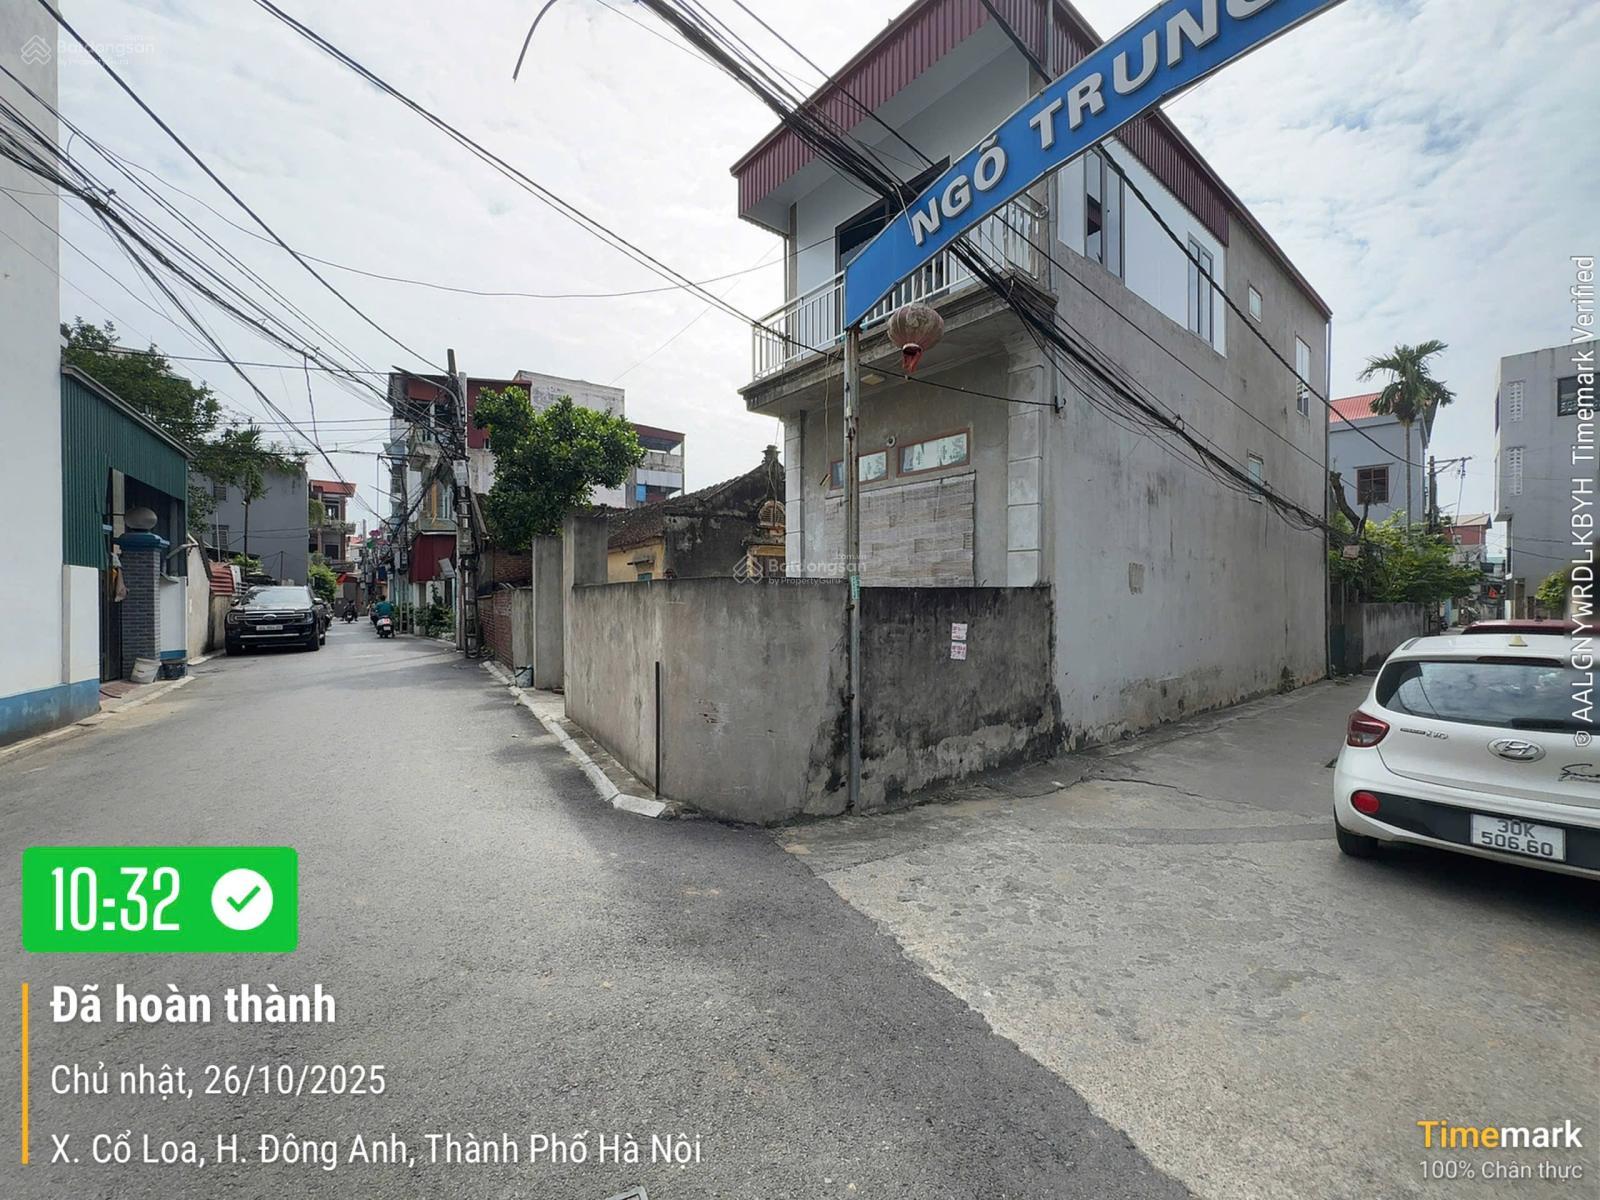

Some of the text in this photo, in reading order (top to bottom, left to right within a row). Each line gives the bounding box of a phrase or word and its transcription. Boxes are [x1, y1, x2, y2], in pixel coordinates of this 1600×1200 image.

[911, 134, 1008, 247] NGÕ
[1497, 819, 1536, 839] 30K
[1481, 831, 1554, 856] 506.60
